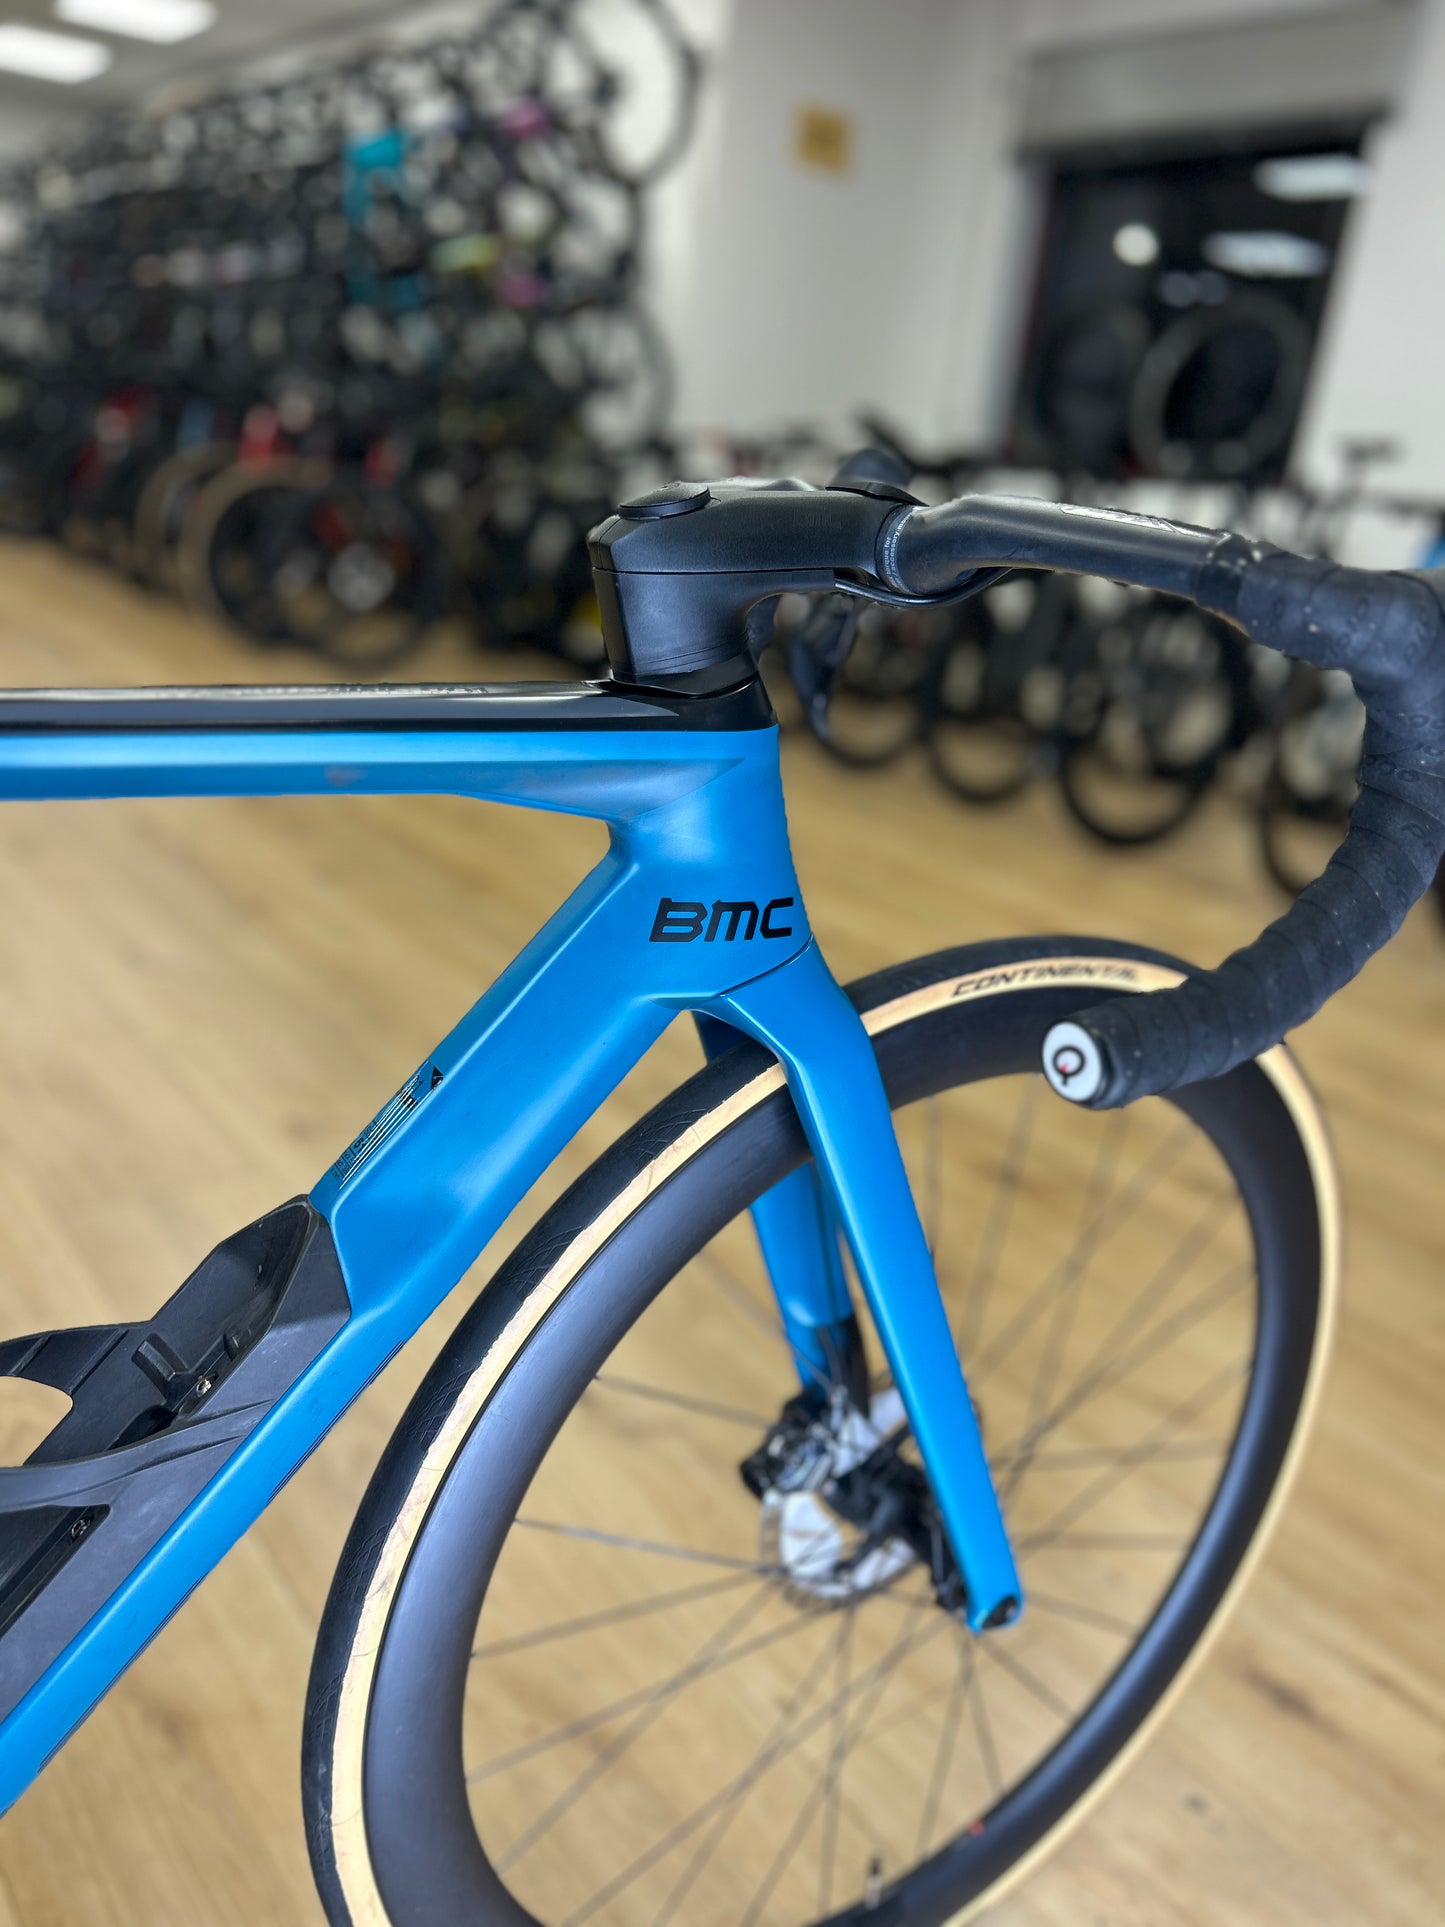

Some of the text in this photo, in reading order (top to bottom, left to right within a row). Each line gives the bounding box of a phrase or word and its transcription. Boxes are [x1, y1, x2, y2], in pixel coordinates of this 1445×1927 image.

[884, 537, 892, 548] for
[890, 531, 900, 572] accessory
[649, 897, 794, 942] BMC
